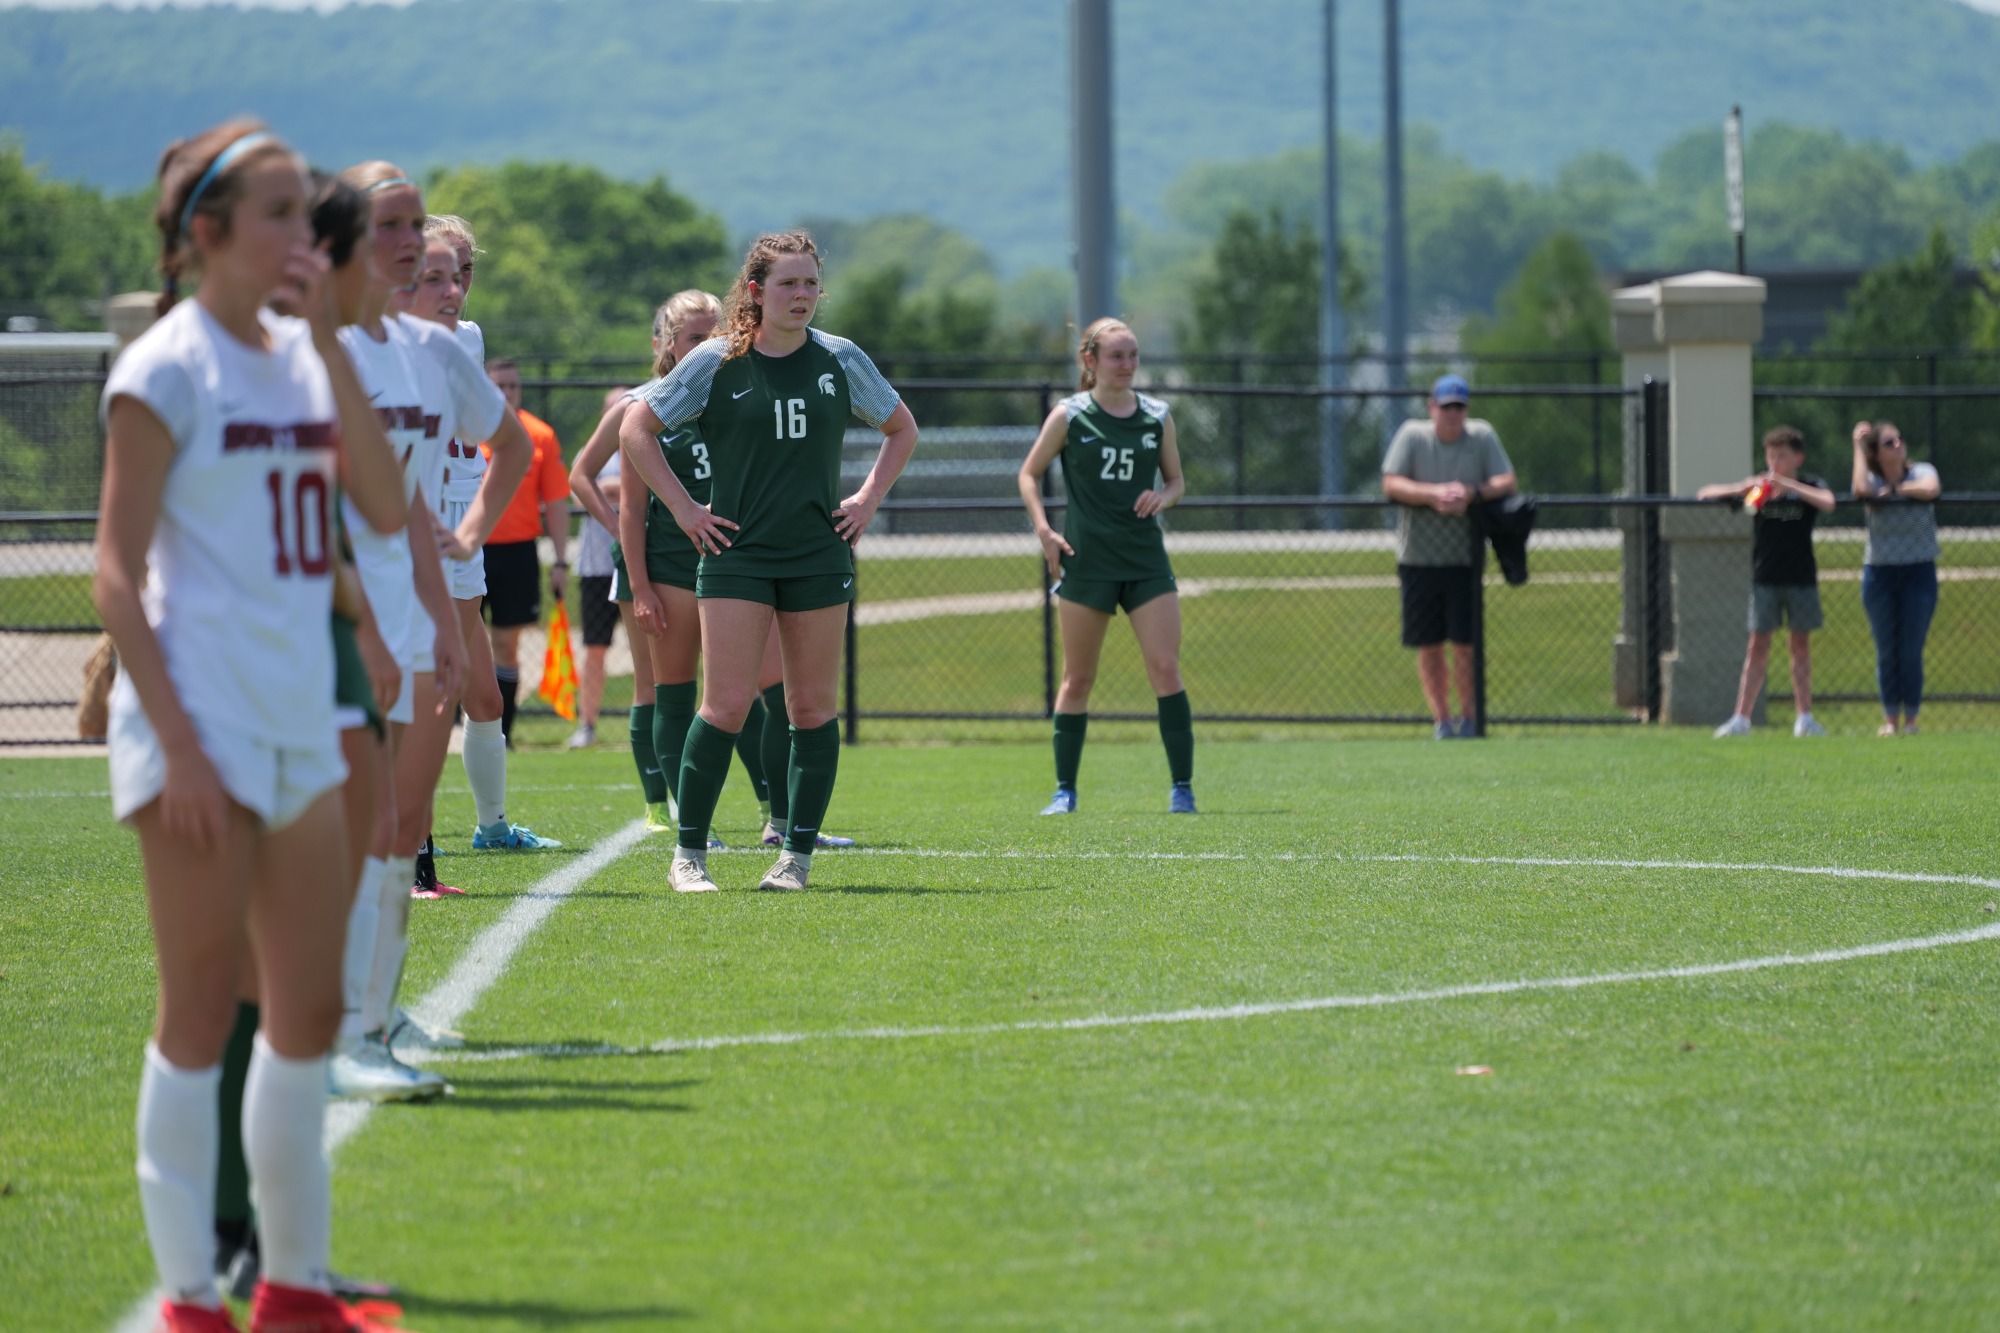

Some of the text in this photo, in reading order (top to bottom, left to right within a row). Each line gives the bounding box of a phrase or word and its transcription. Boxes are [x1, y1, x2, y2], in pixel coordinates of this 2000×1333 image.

[774, 398, 807, 440] 16
[691, 442, 712, 480] 3
[1101, 446, 1135, 481] 25
[266, 469, 330, 577] 10
